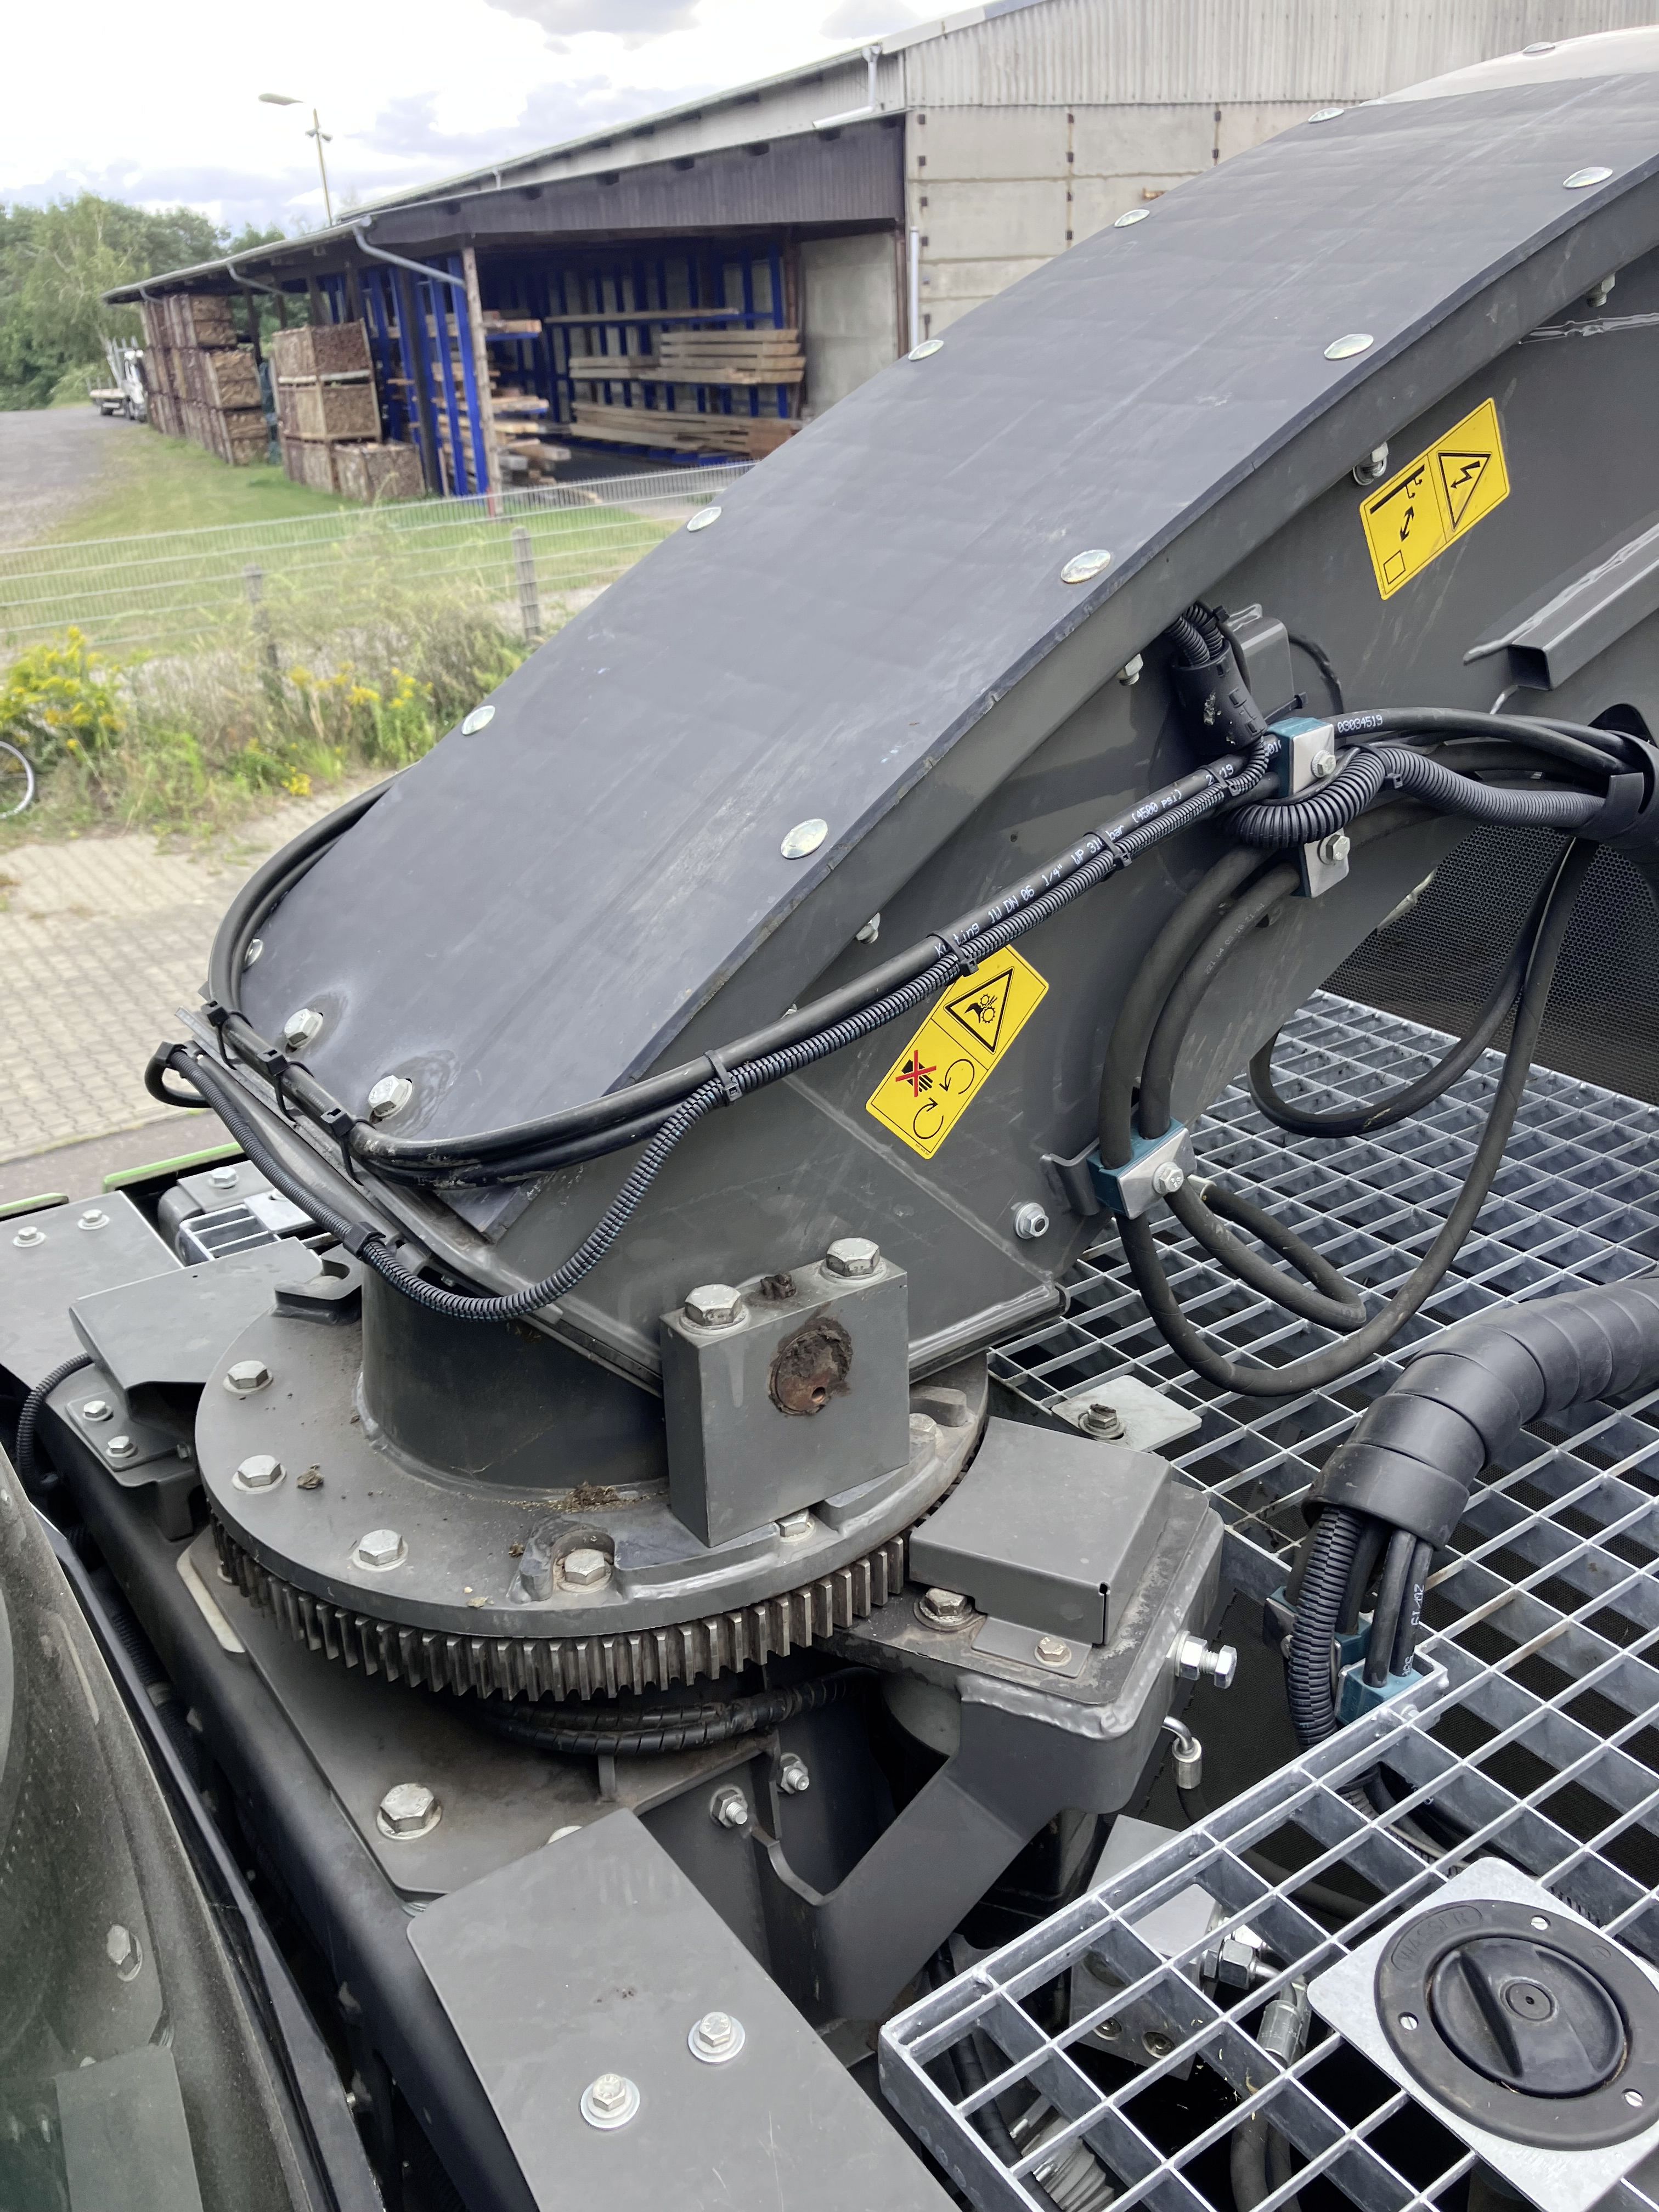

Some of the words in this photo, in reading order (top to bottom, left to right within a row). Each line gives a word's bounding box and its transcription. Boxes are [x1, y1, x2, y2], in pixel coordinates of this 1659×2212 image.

[1002, 894, 1019, 913] DN
[1020, 884, 1035, 901] 06
[1041, 862, 1063, 887] 1/4"
[1070, 848, 1085, 866] WP
[1105, 824, 1125, 842] bar
[1131, 801, 1159, 824] (4500
[1161, 788, 1182, 809] psi)
[1337, 714, 1383, 733] 03034519
